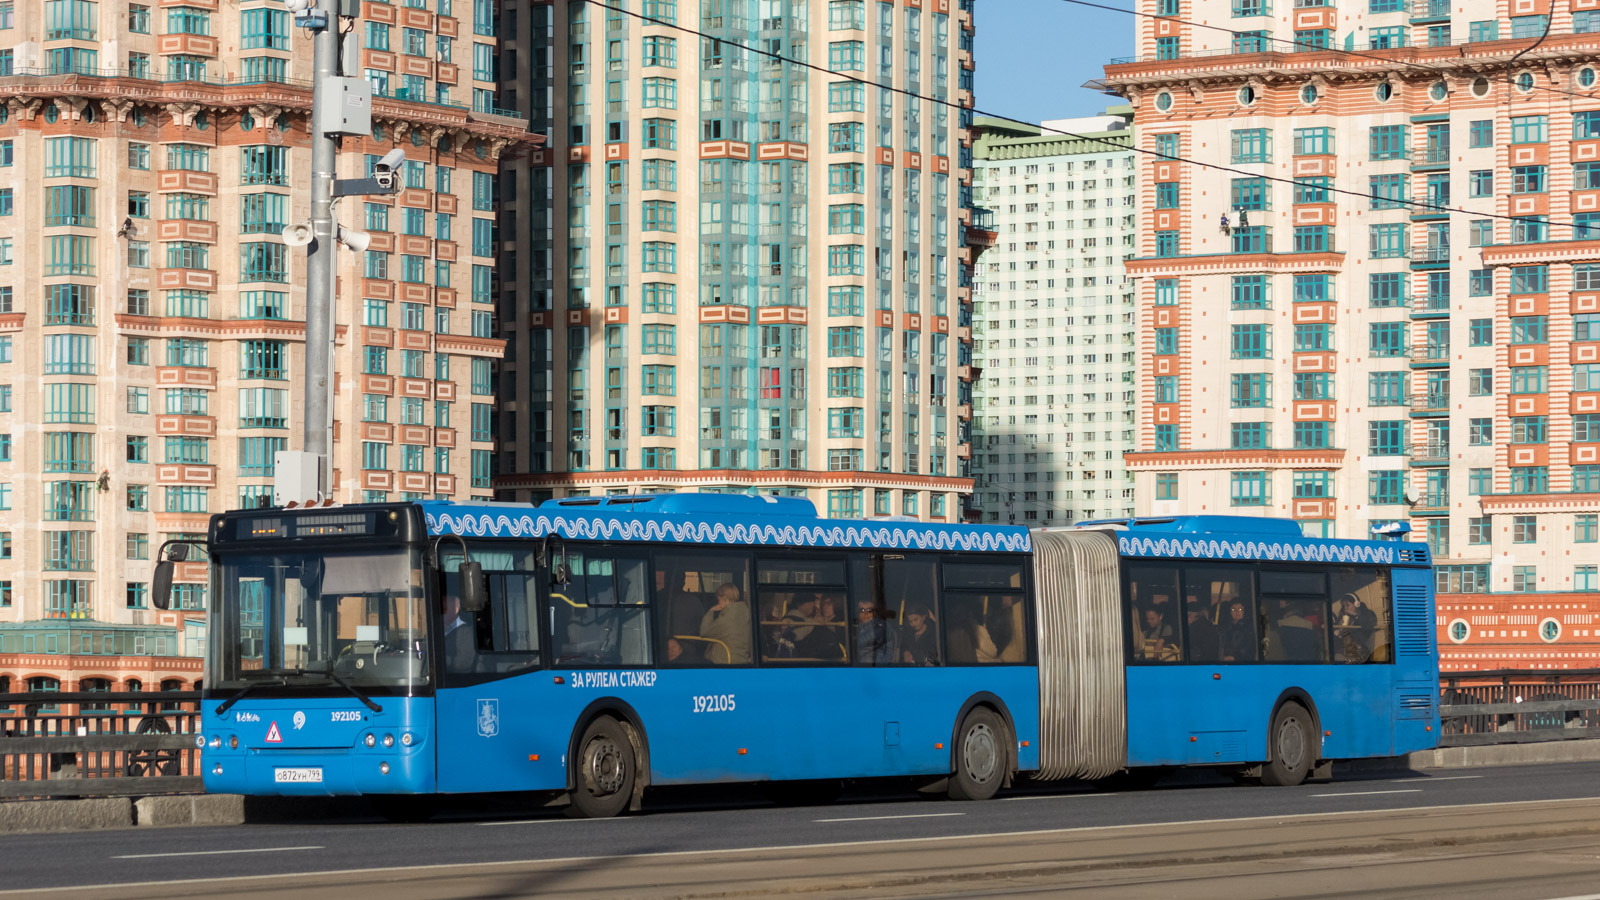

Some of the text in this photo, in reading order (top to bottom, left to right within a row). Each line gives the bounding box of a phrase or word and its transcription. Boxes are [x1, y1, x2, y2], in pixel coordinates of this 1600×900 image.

[571, 671, 657, 688] ЗА РУЛЕМ СТАЖЕР
[693, 694, 736, 713] 192105
[331, 711, 361, 722] 192105
[308, 769, 320, 778] 799
